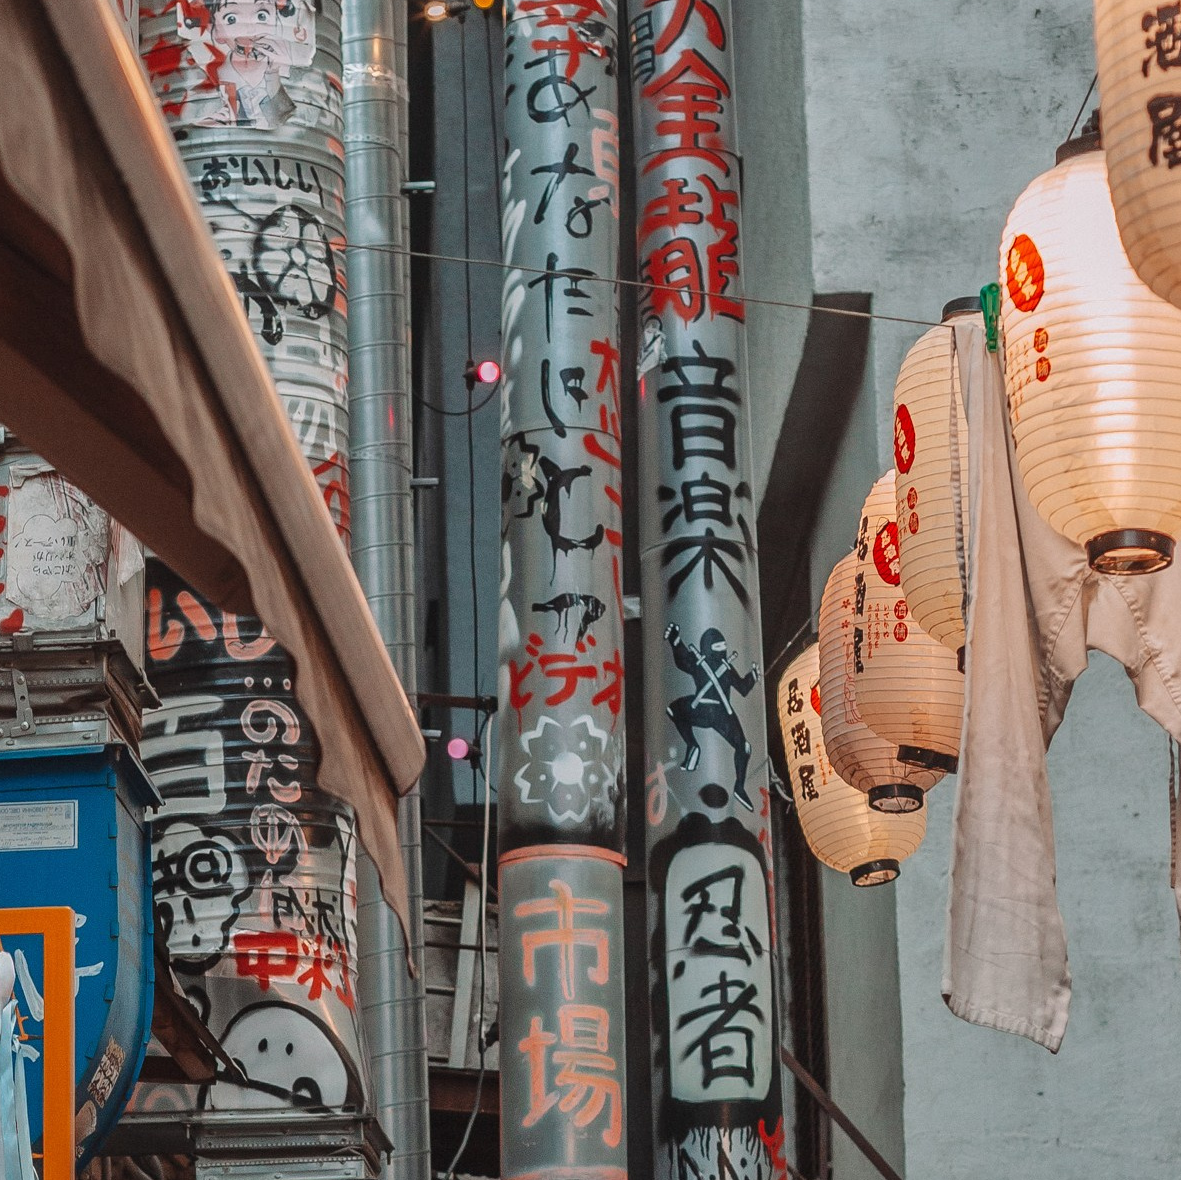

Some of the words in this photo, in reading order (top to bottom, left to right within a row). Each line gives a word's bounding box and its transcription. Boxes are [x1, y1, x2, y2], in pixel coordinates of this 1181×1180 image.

[786, 677, 820, 802] 居酒屋
[514, 879, 621, 1148] 市場
